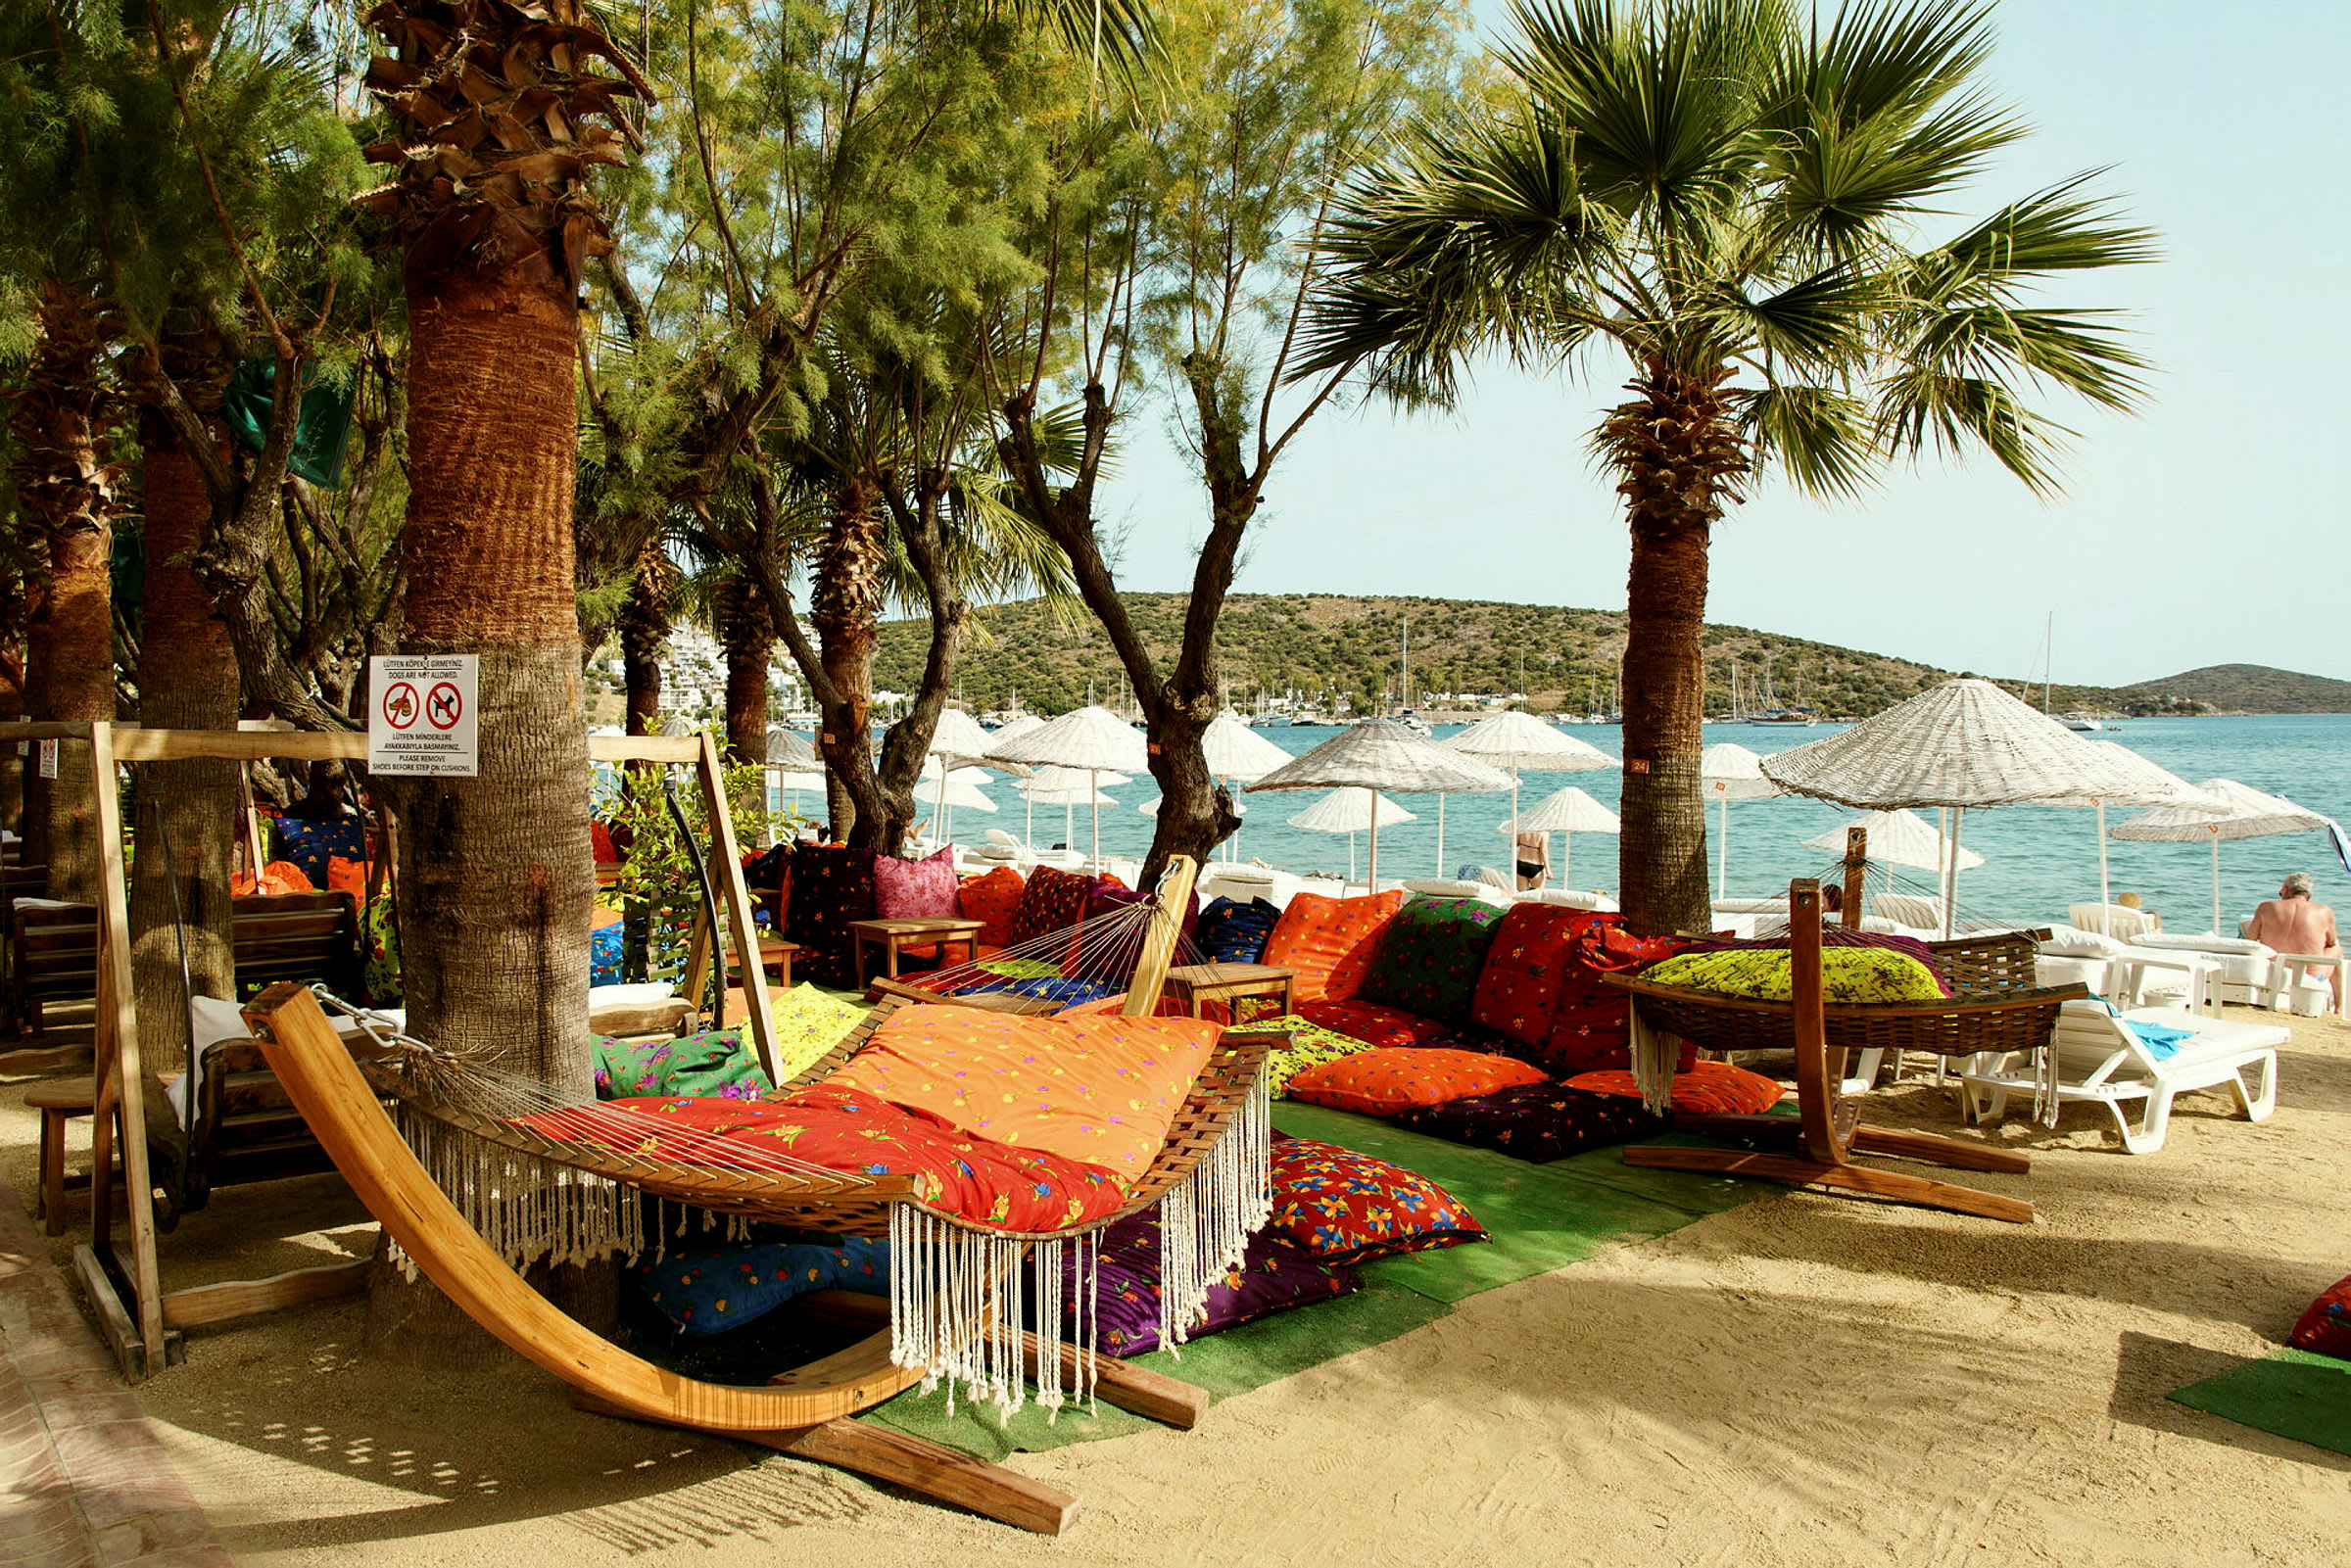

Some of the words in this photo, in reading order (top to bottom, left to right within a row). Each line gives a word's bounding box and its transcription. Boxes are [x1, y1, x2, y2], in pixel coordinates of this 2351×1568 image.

[383, 659, 404, 667] LÜTFEN
[406, 659, 430, 667] KÖPEKE
[388, 671, 405, 679] DOGS
[406, 671, 416, 679] ARE
[393, 732, 414, 740] LÜTFEN
